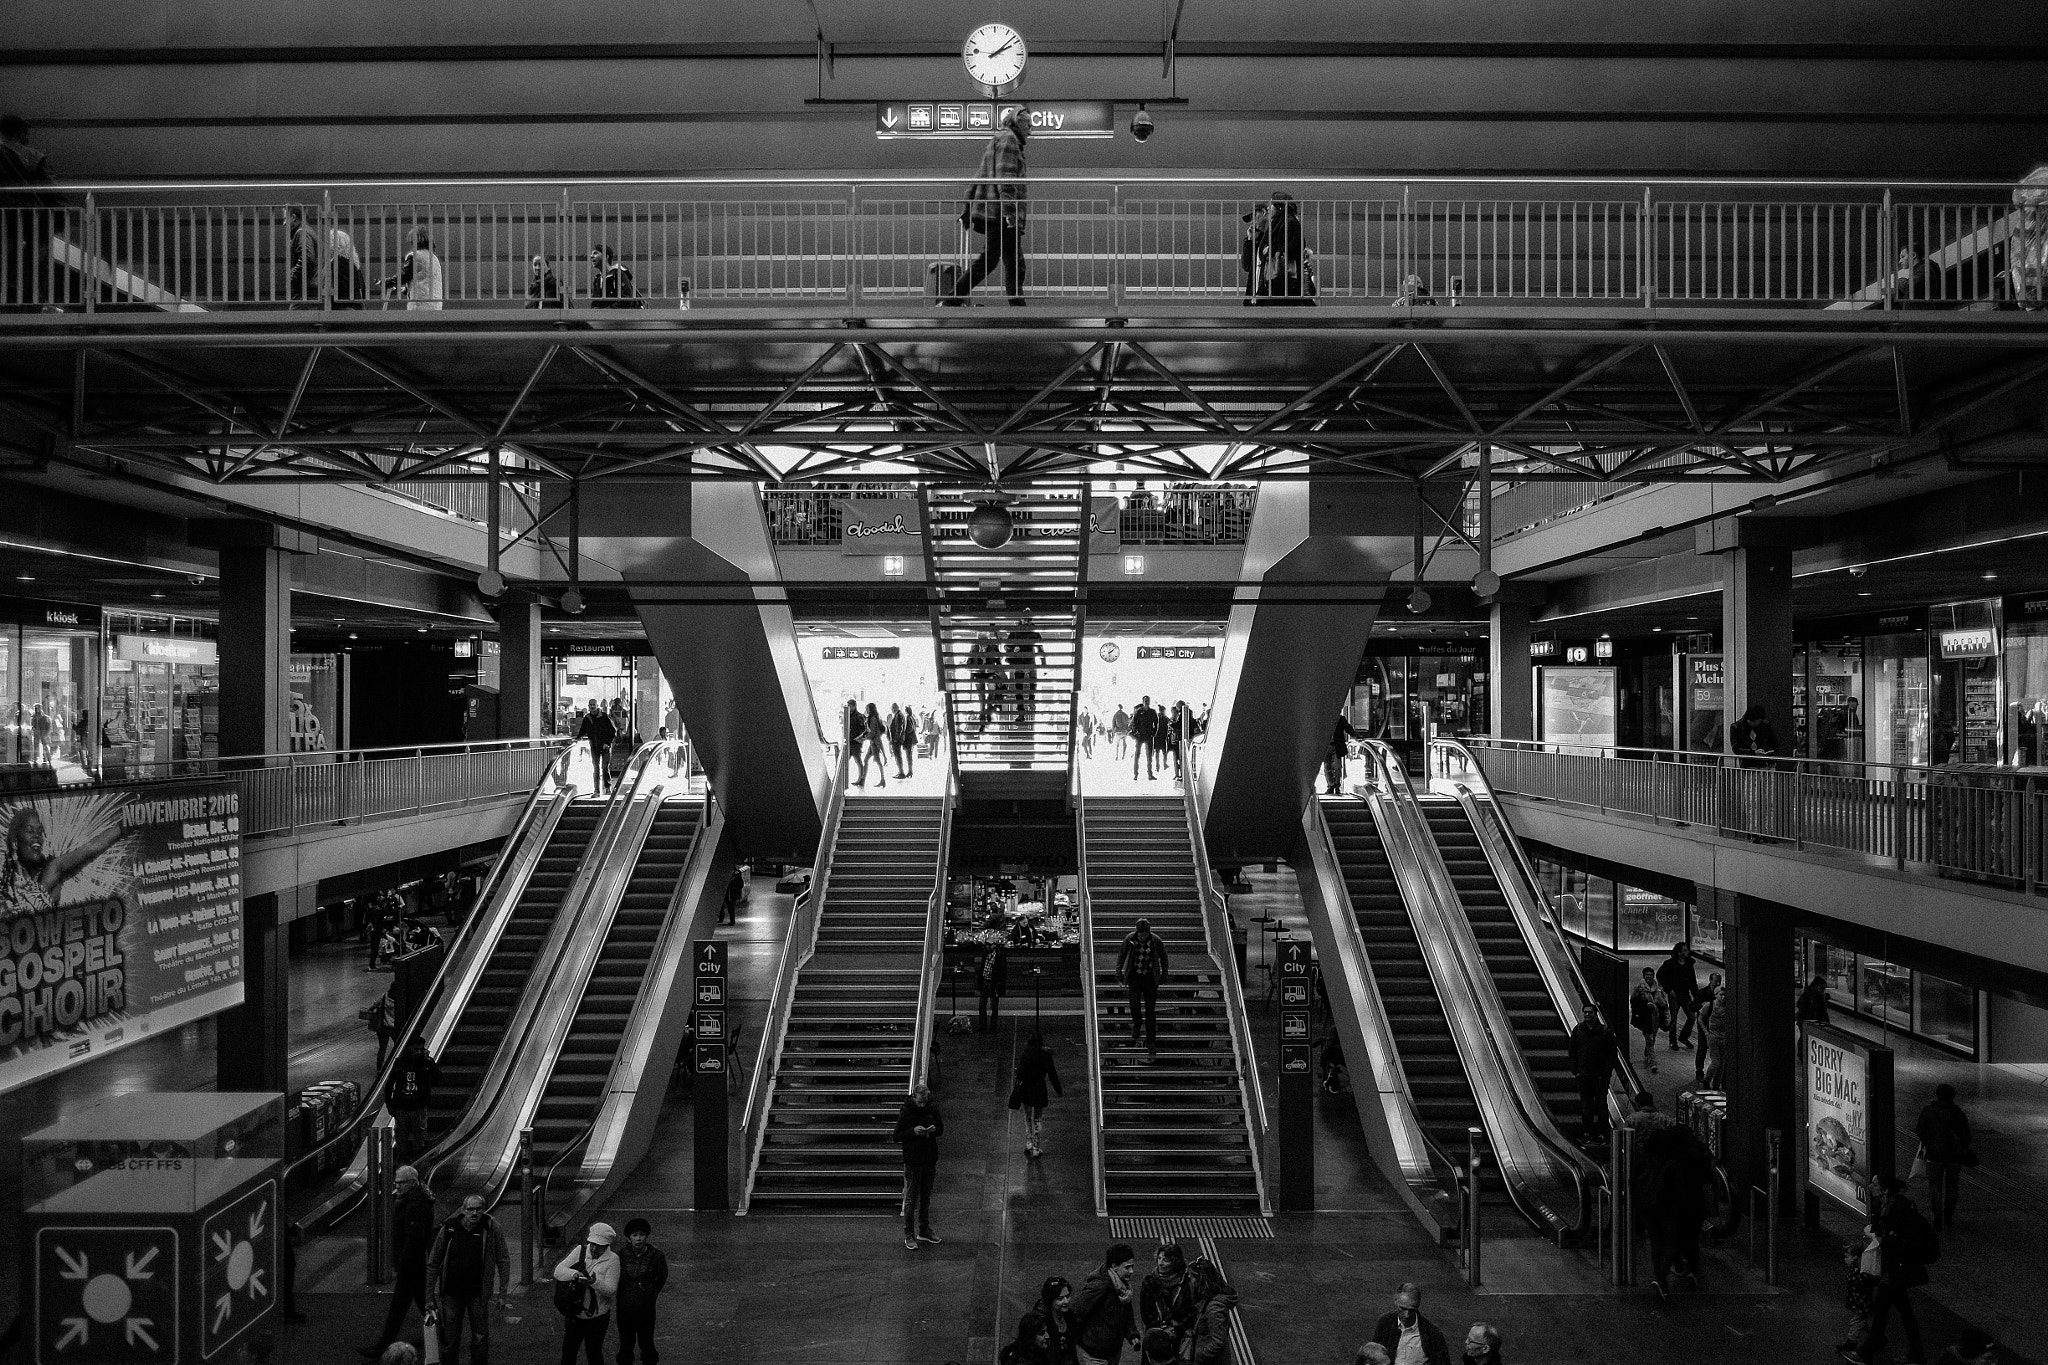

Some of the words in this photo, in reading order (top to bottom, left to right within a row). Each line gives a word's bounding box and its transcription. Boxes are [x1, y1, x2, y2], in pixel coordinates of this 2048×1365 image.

[1031, 112, 1064, 130] City
[53, 611, 79, 625] kiosk
[340, 644, 383, 652] Rtaurant
[570, 644, 615, 652] Restaurant
[1446, 645, 1457, 653] du
[1947, 637, 1987, 652] APERTO
[862, 649, 880, 660] City
[1178, 649, 1195, 660] City
[1694, 661, 1719, 672] Plus
[122, 797, 207, 827] NOVEMBRE
[208, 793, 239, 817] 2016
[168, 841, 193, 850] Theater
[194, 836, 219, 846] National
[133, 863, 144, 877] LA
[169, 869, 200, 880] Populaire
[201, 863, 227, 873] Romand
[1625, 893, 1663, 901] geöffnet
[1619, 906, 1649, 914] schnell
[1655, 912, 1679, 922] käse
[147, 921, 158, 934] LA
[197, 923, 213, 931] Salle
[214, 917, 227, 926] CO2
[185, 955, 194, 963] du
[0, 934, 123, 997] GOSPEL
[699, 962, 721, 974] City
[1284, 963, 1306, 975] City
[187, 980, 208, 991] Léman
[0, 968, 124, 1046] CHOIR
[1811, 1040, 1844, 1073] SORRY
[1815, 1067, 1832, 1095] BIG
[128, 1159, 154, 1171] CFF
[157, 1159, 182, 1171] FFS
